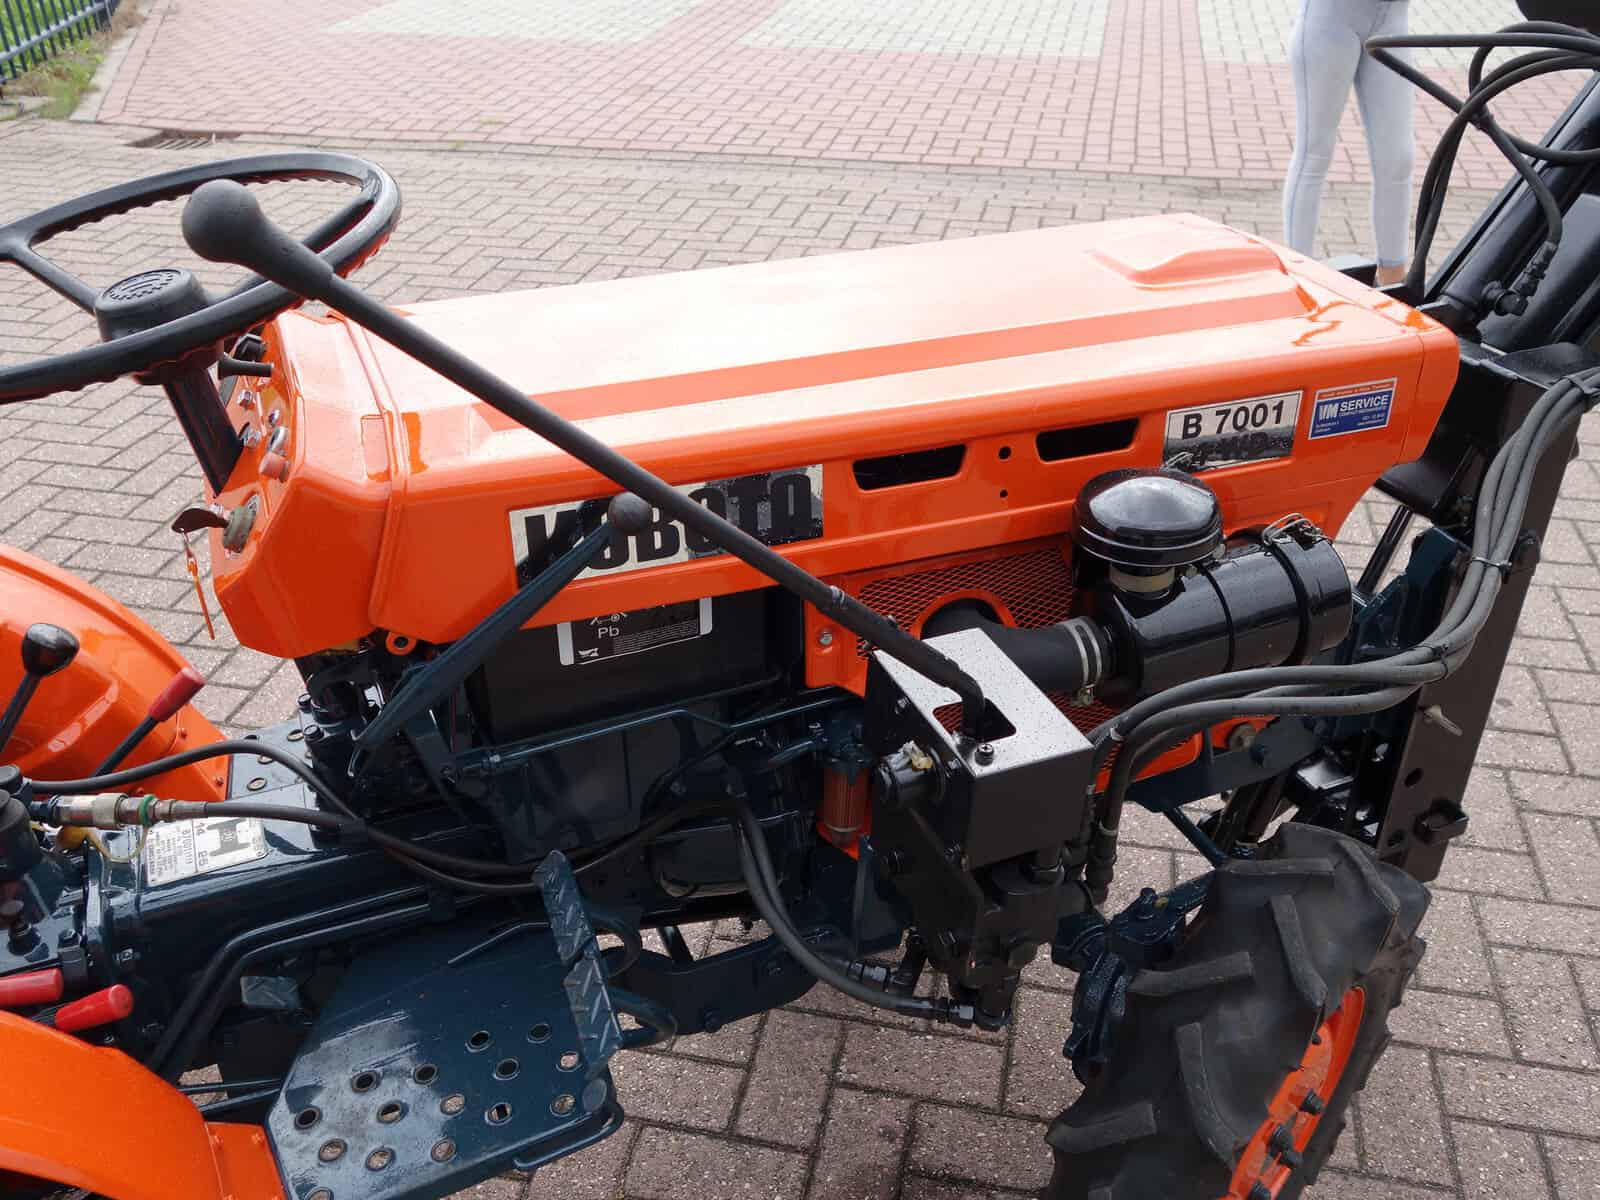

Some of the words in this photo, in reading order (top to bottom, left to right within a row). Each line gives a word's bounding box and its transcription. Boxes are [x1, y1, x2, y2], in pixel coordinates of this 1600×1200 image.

[1340, 394, 1389, 412] SERVICE
[1181, 413, 1202, 440] B
[1215, 399, 1284, 434] 7001
[598, 625, 620, 640] Pb
